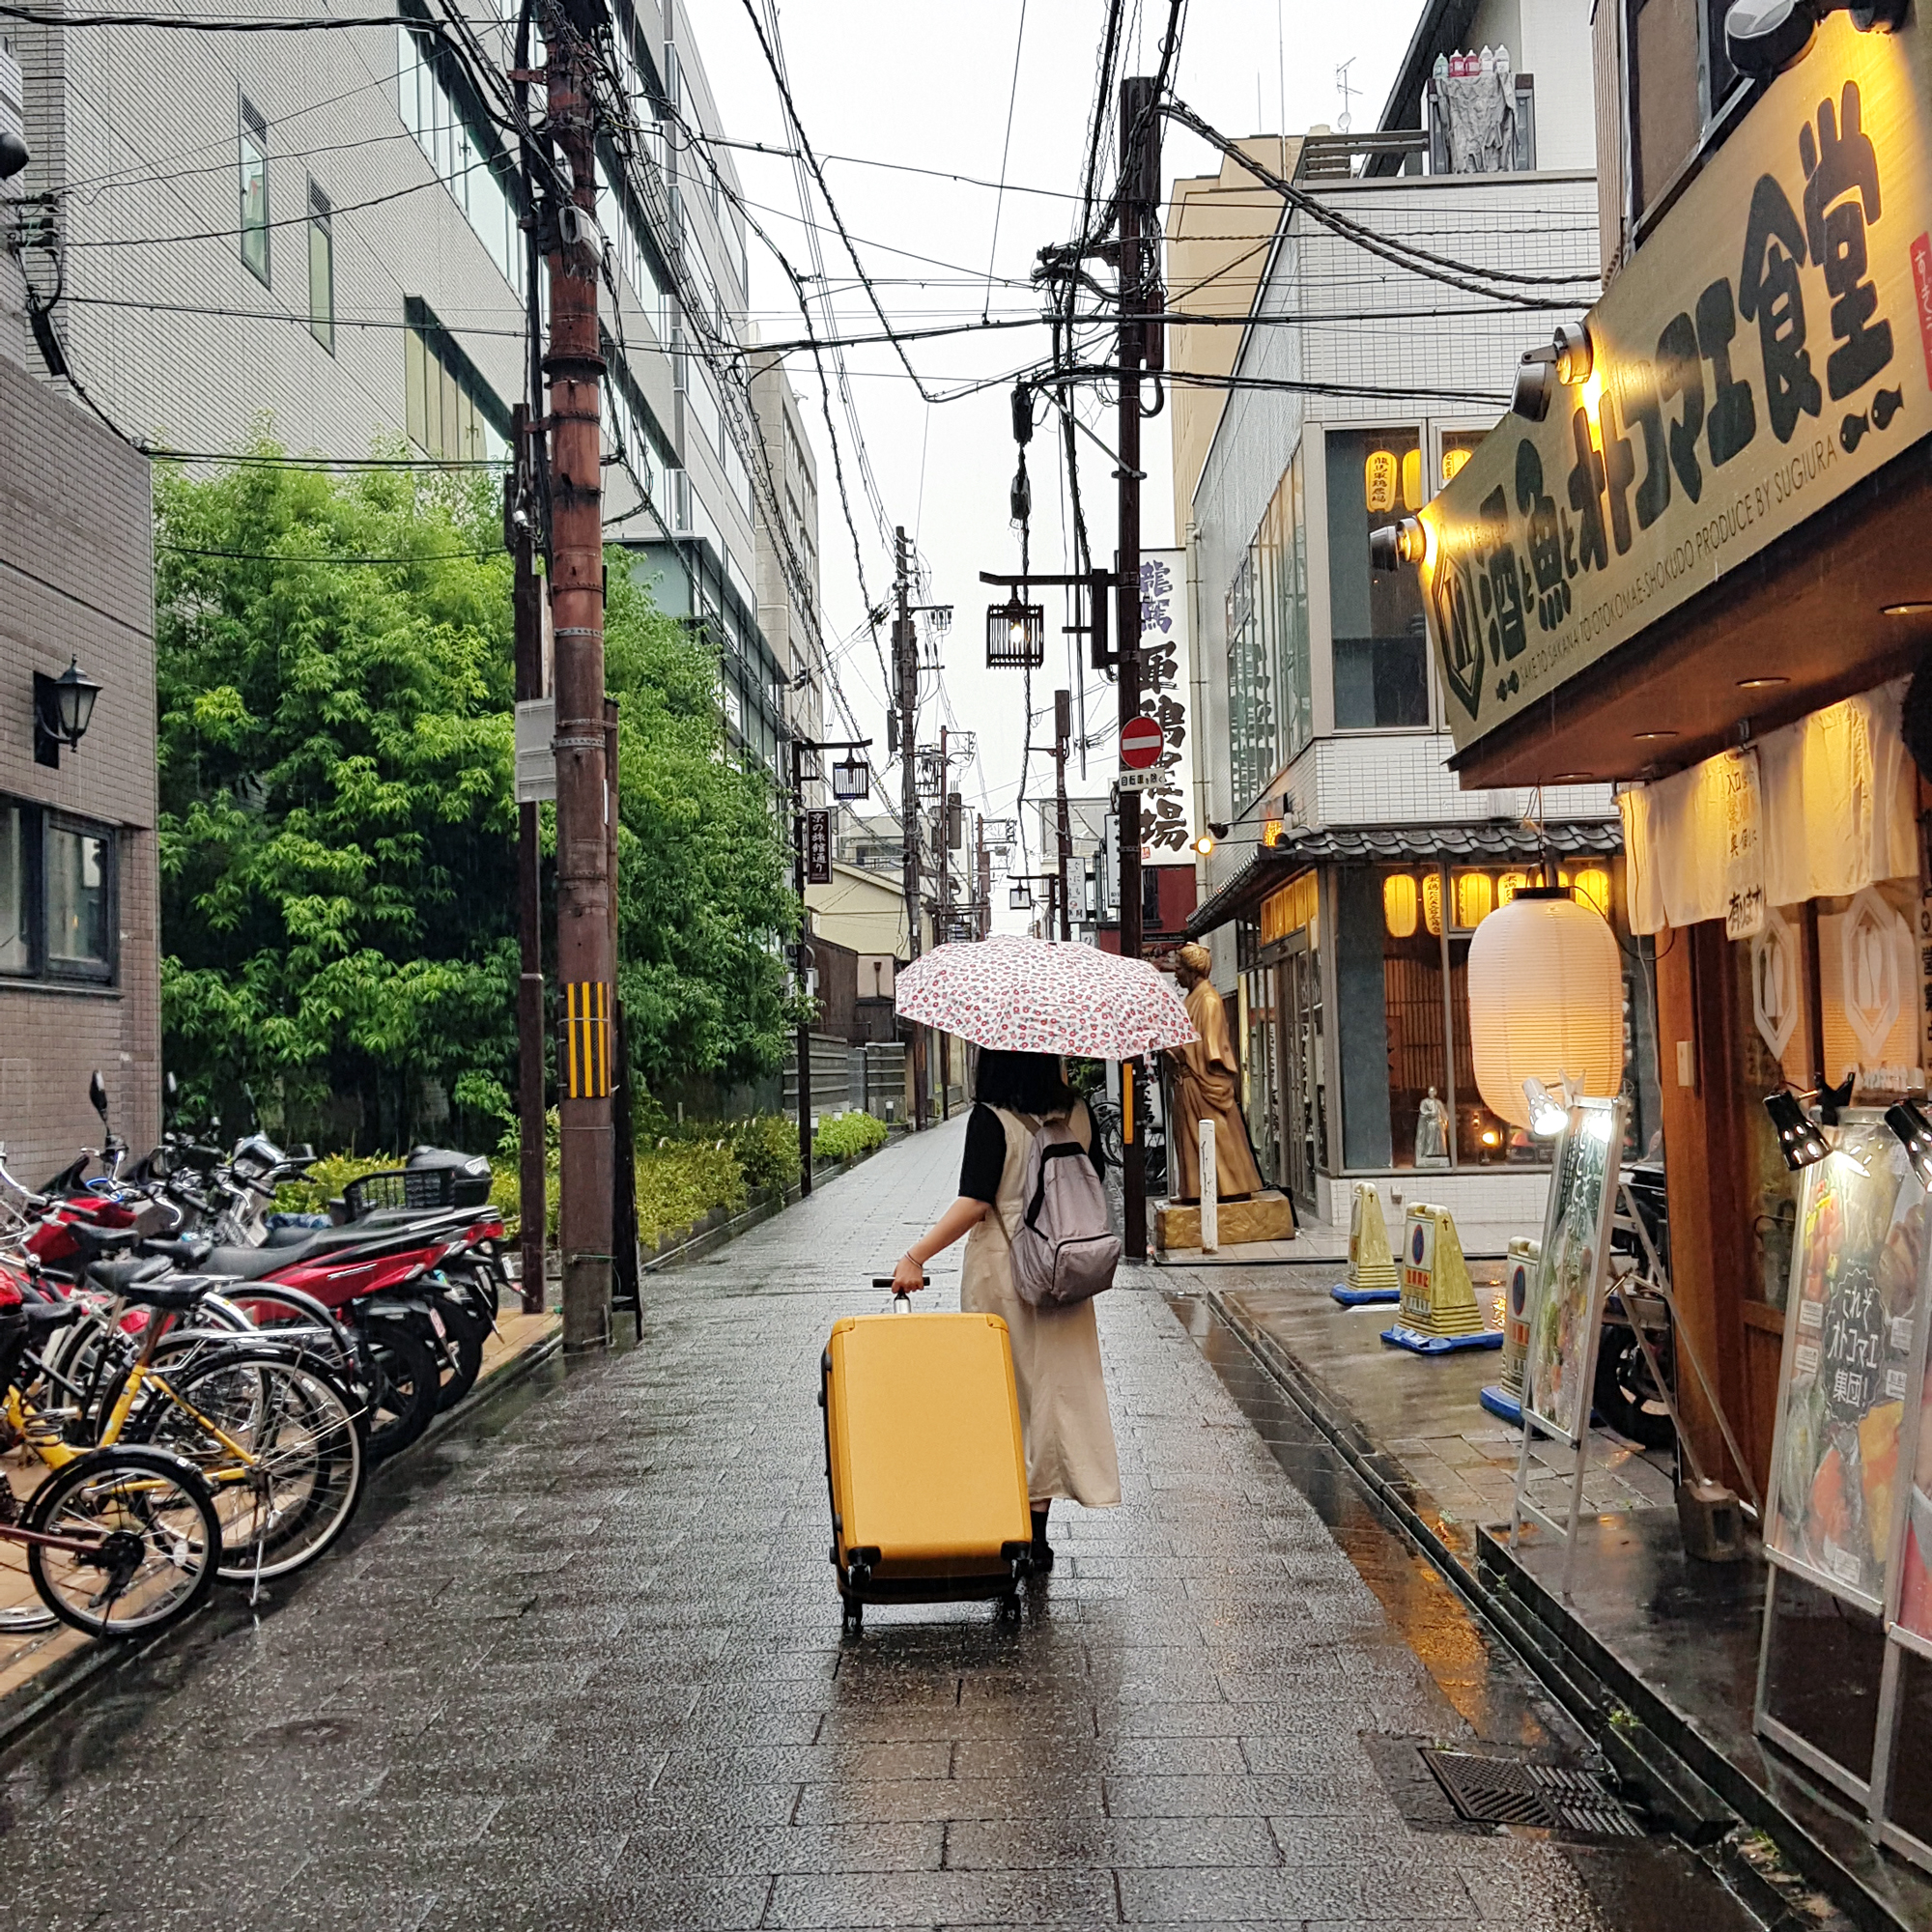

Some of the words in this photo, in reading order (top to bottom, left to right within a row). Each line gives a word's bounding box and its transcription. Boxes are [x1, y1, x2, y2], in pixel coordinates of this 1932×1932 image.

[1479, 80, 1894, 668] 酒と魚とオトコマエ食堂
[1520, 656, 1539, 687] SAKE
[1536, 650, 1548, 673] TO
[1547, 634, 1579, 671] SAKANA
[1578, 617, 1591, 642] TO
[1593, 539, 1694, 635] OTOKOMAE-SHOKUDO
[1695, 494, 1754, 560] PRODUCE
[1755, 479, 1772, 518] BY
[1774, 435, 1838, 503] SUGIURA
[1122, 773, 1162, 786] 自転車を除く
[810, 812, 827, 873] 京の旅館通り
[1843, 1286, 1875, 1332] これぞ
[1828, 1319, 1879, 1370] オトコマエ
